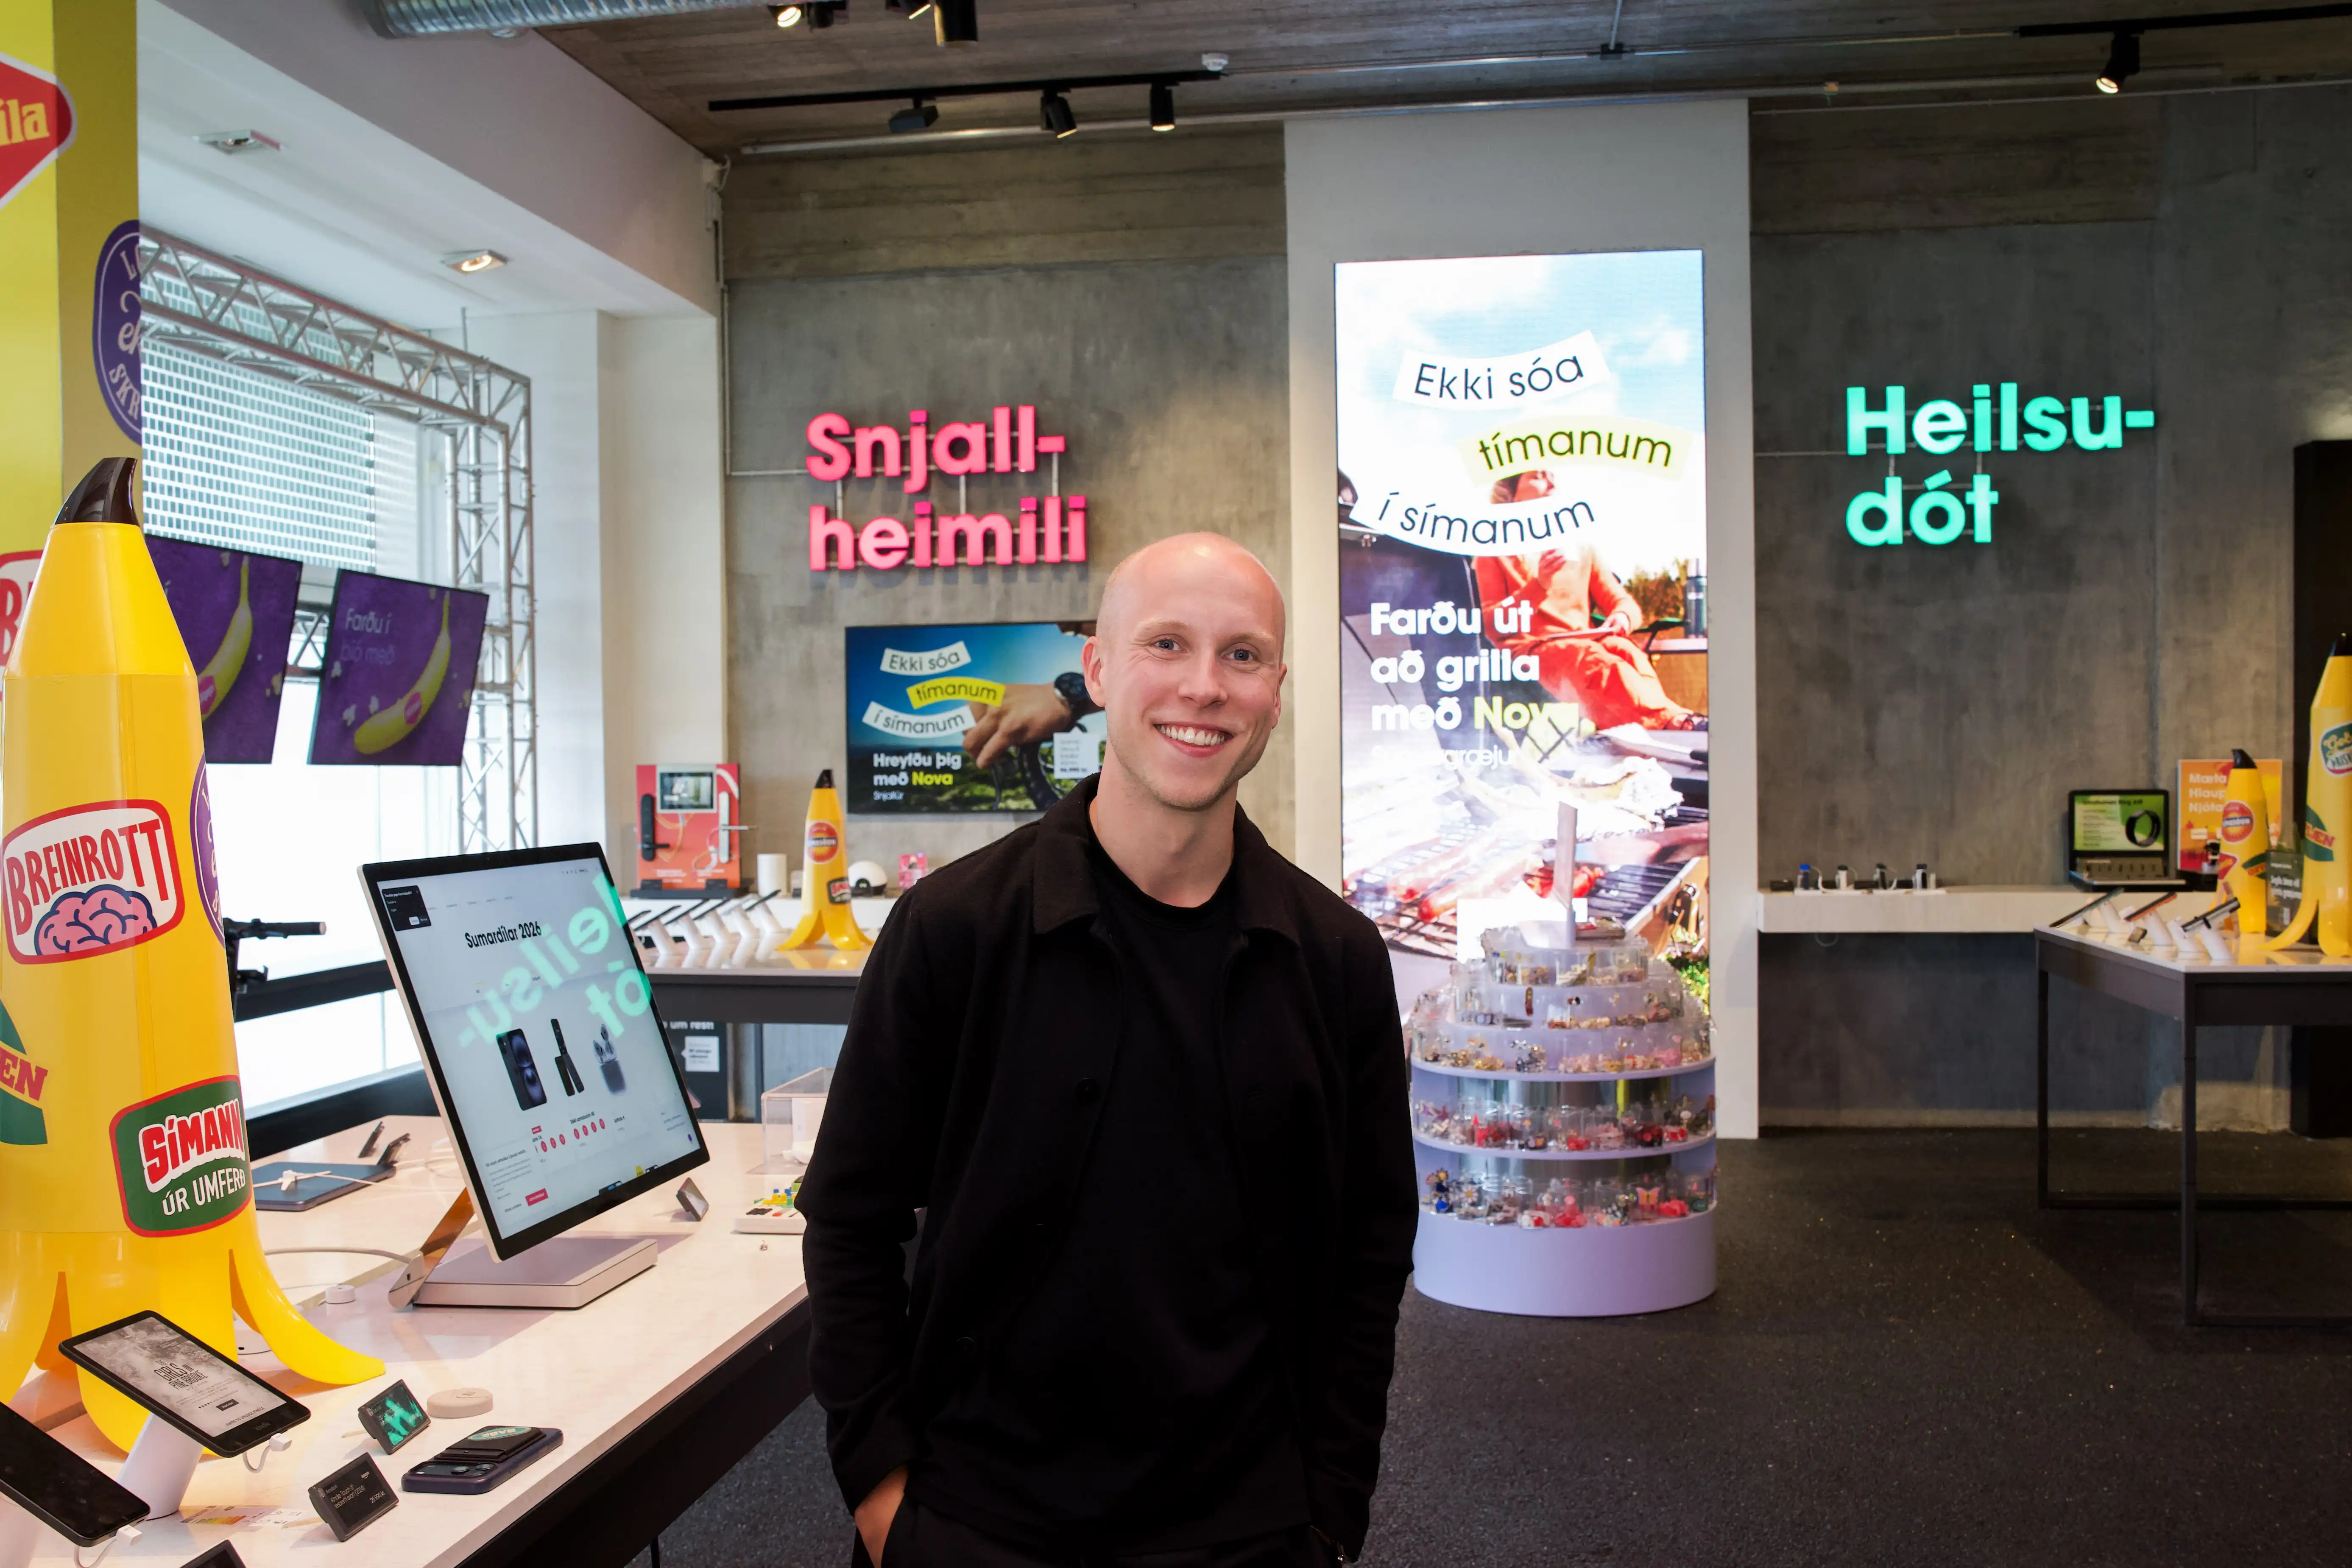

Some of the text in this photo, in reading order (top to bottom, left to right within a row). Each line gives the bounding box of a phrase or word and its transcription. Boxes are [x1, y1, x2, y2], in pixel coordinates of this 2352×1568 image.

[1414, 354, 1584, 399] Ekki sóa
[1846, 382, 2155, 456] Heilsu-
[806, 405, 1065, 494] Snjall-
[1478, 430, 1671, 470] tímanum
[1399, 500, 1595, 544] símanum
[1846, 469, 1999, 546] dót
[809, 495, 1086, 571] heimili
[345, 608, 393, 634] Farðu í
[1370, 597, 1534, 636] Farðu út
[890, 650, 961, 672] Ekki sóa
[1370, 648, 1540, 692] að grilla
[915, 683, 998, 701] tímanum
[883, 713, 965, 734] símanum
[1371, 696, 1462, 731] með
[873, 753, 962, 770] Hreyfðu þig
[873, 772, 953, 787] með Nova
[6, 818, 169, 935] BREINROTT
[465, 921, 542, 948] Sumardílar 2026
[162, 1190, 190, 1216] ÚR
[153, 1363, 195, 1381] GIRLS IN
[168, 1378, 189, 1390] PINE
[180, 1370, 208, 1385] BROOKE
